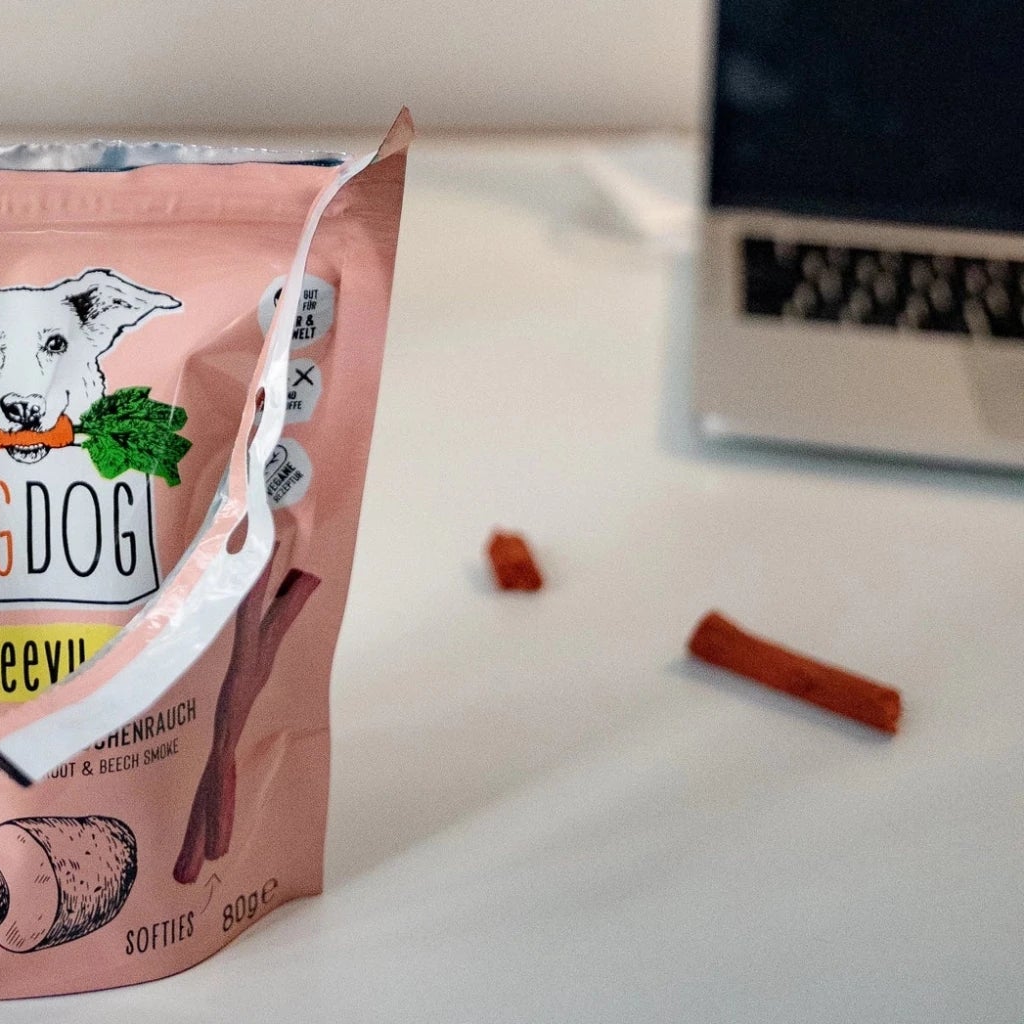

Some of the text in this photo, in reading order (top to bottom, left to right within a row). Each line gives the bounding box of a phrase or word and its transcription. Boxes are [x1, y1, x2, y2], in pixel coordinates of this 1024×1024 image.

[303, 289, 318, 300] GUT
[81, 760, 93, 777] &
[99, 753, 140, 775] BEECH
[143, 737, 179, 765] SMOKE
[126, 910, 195, 955] SOFTIES
